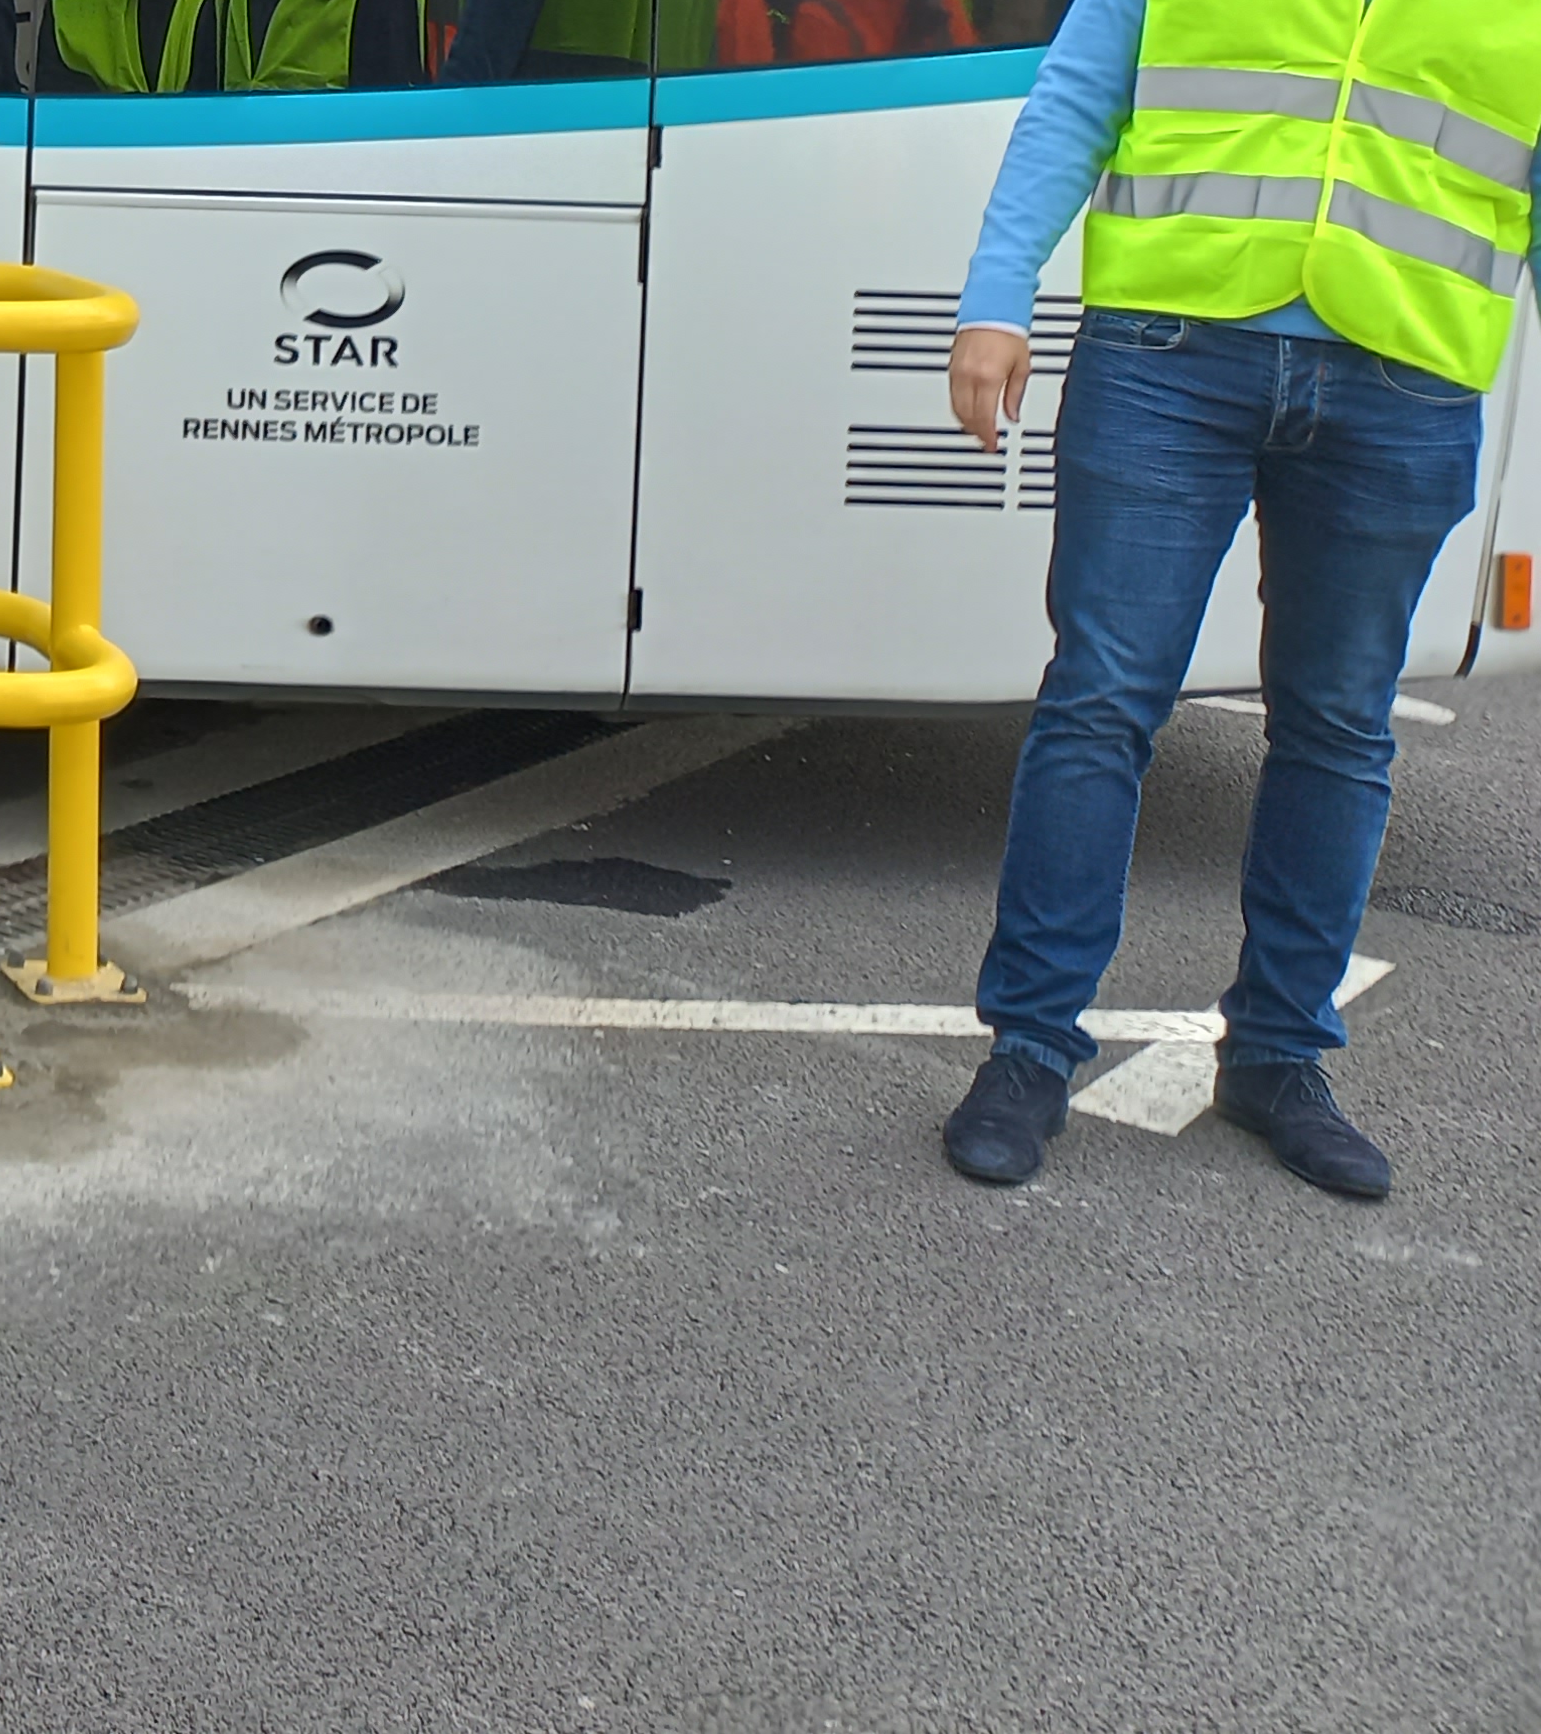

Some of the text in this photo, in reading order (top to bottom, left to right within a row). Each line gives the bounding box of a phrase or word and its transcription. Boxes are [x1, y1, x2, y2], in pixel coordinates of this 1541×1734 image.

[274, 332, 399, 369] STAR
[226, 387, 439, 416] UN SERVICE DE
[181, 415, 481, 447] RENNES MÉTROPOLE
